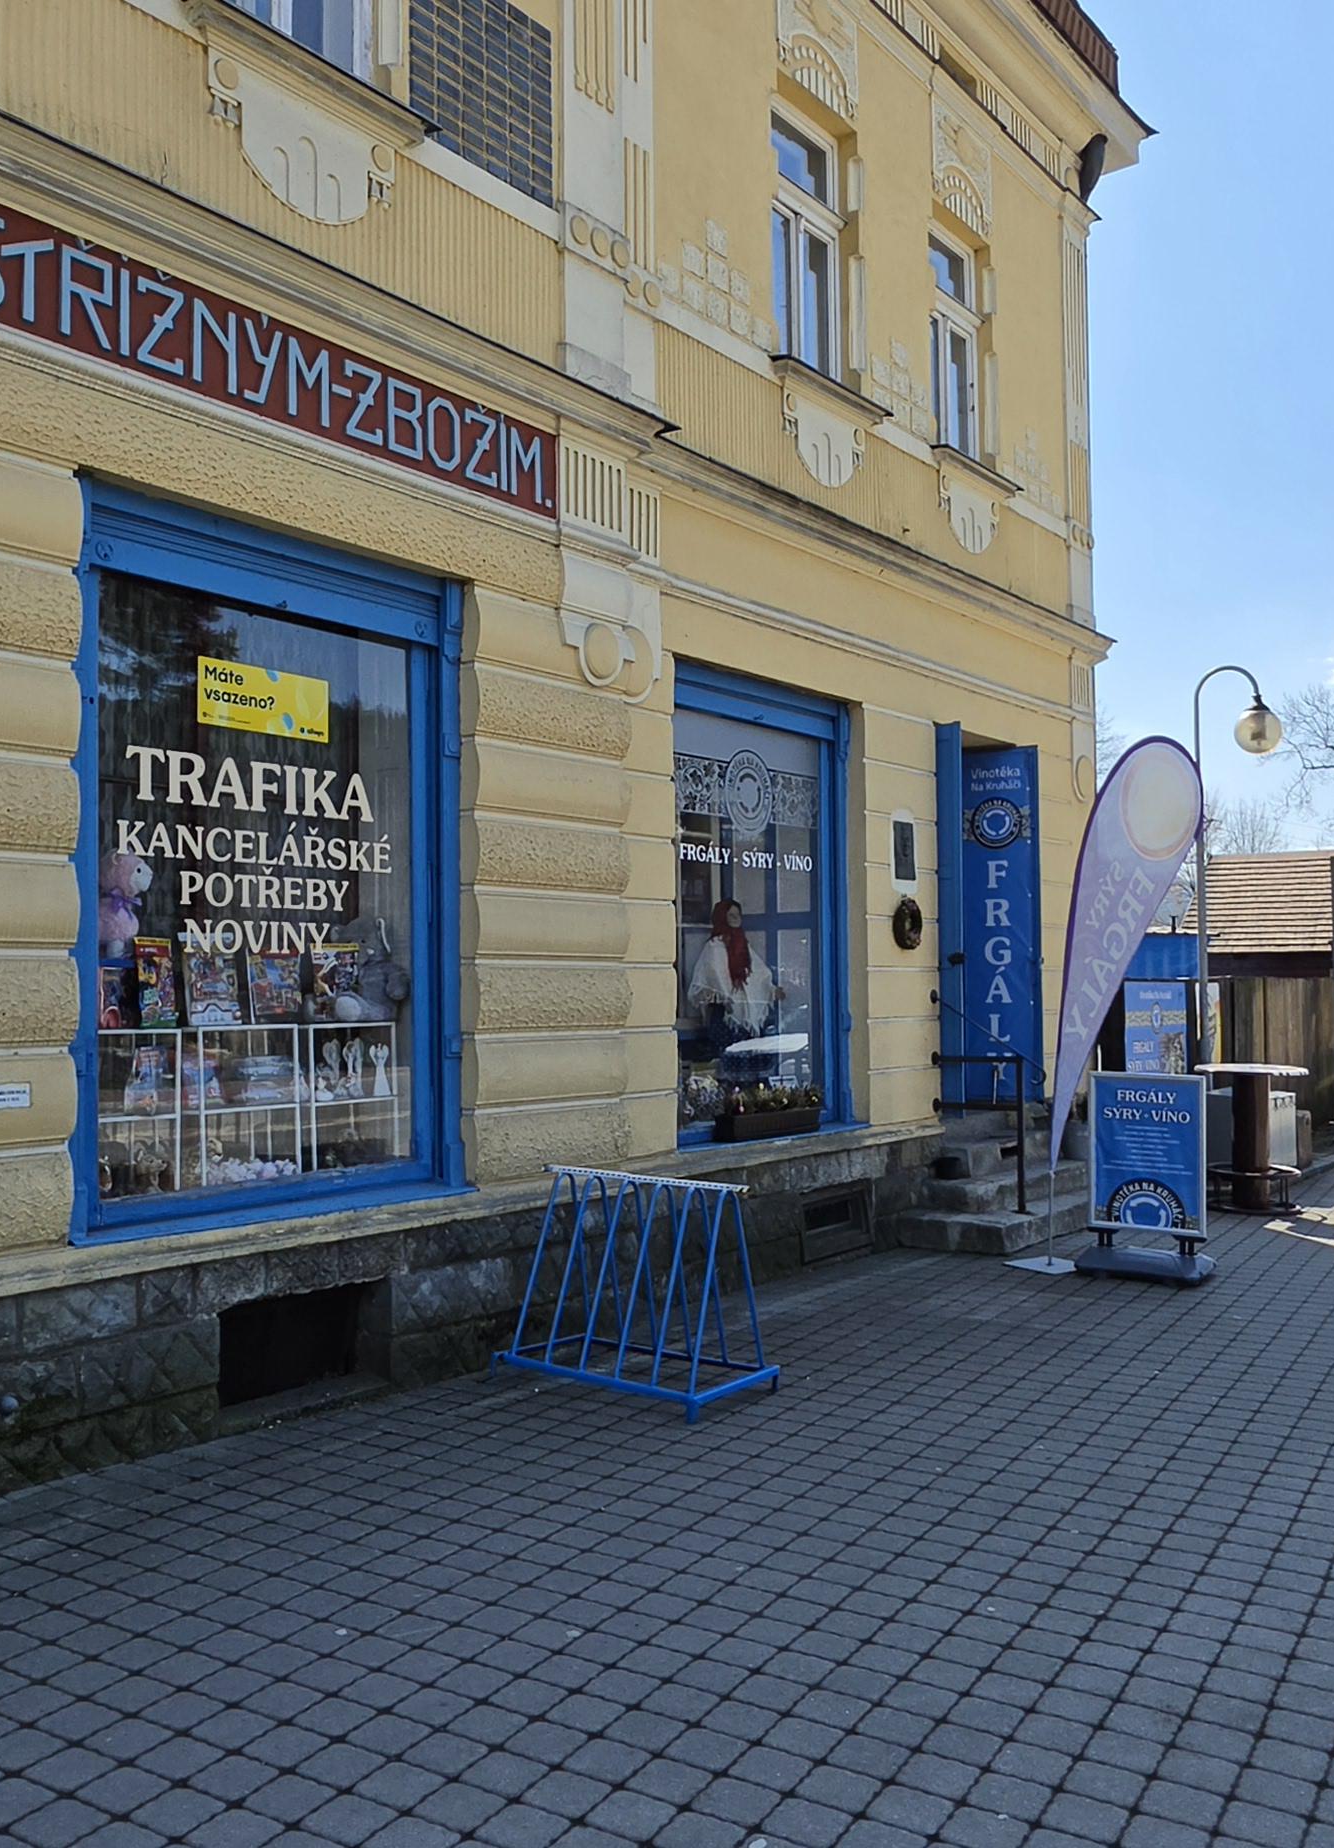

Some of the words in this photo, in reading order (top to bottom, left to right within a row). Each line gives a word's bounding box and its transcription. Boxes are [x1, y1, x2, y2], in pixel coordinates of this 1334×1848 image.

[204, 665, 244, 686] Máte
[203, 688, 275, 710] vsazeno?
[125, 745, 374, 822] TRAFIKA
[971, 765, 1021, 780] Vinotéka
[117, 819, 392, 874] KANCELÁŘSKÉ
[679, 841, 731, 865] FRGÁLY
[742, 847, 774, 869] SÝRY
[784, 850, 813, 872] VÍNO
[179, 866, 349, 912] POTŘEBY
[183, 918, 331, 954] NOVINY
[1116, 1088, 1177, 1105] FRGÁLY
[1103, 1104, 1143, 1120] SÝRY
[1150, 1107, 1191, 1124] VÍNO
